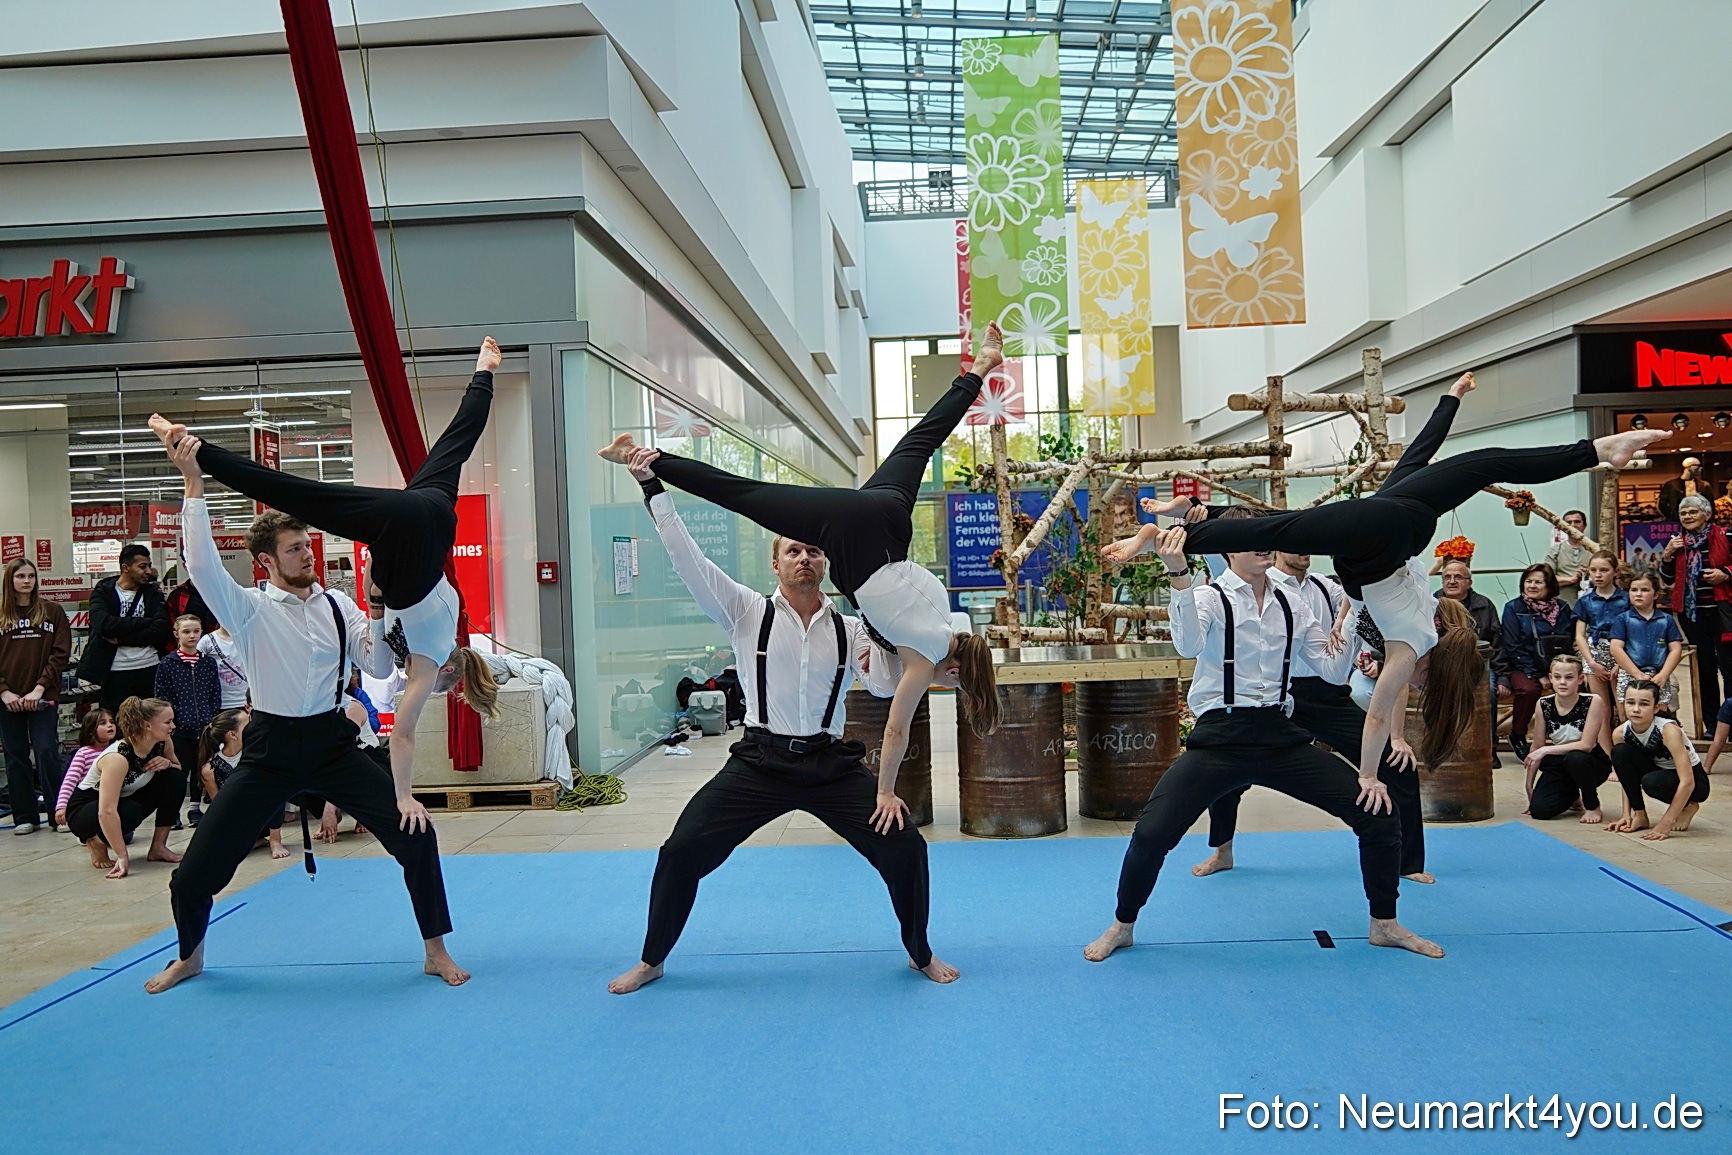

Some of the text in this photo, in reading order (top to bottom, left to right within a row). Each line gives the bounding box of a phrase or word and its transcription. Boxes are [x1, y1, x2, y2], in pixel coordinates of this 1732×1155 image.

[955, 500, 995, 511] Ich hab
[955, 511, 1000, 523] den klei
[110, 528, 129, 536] Sofot
[1650, 524, 1679, 532] PURE
[956, 537, 975, 547] der
